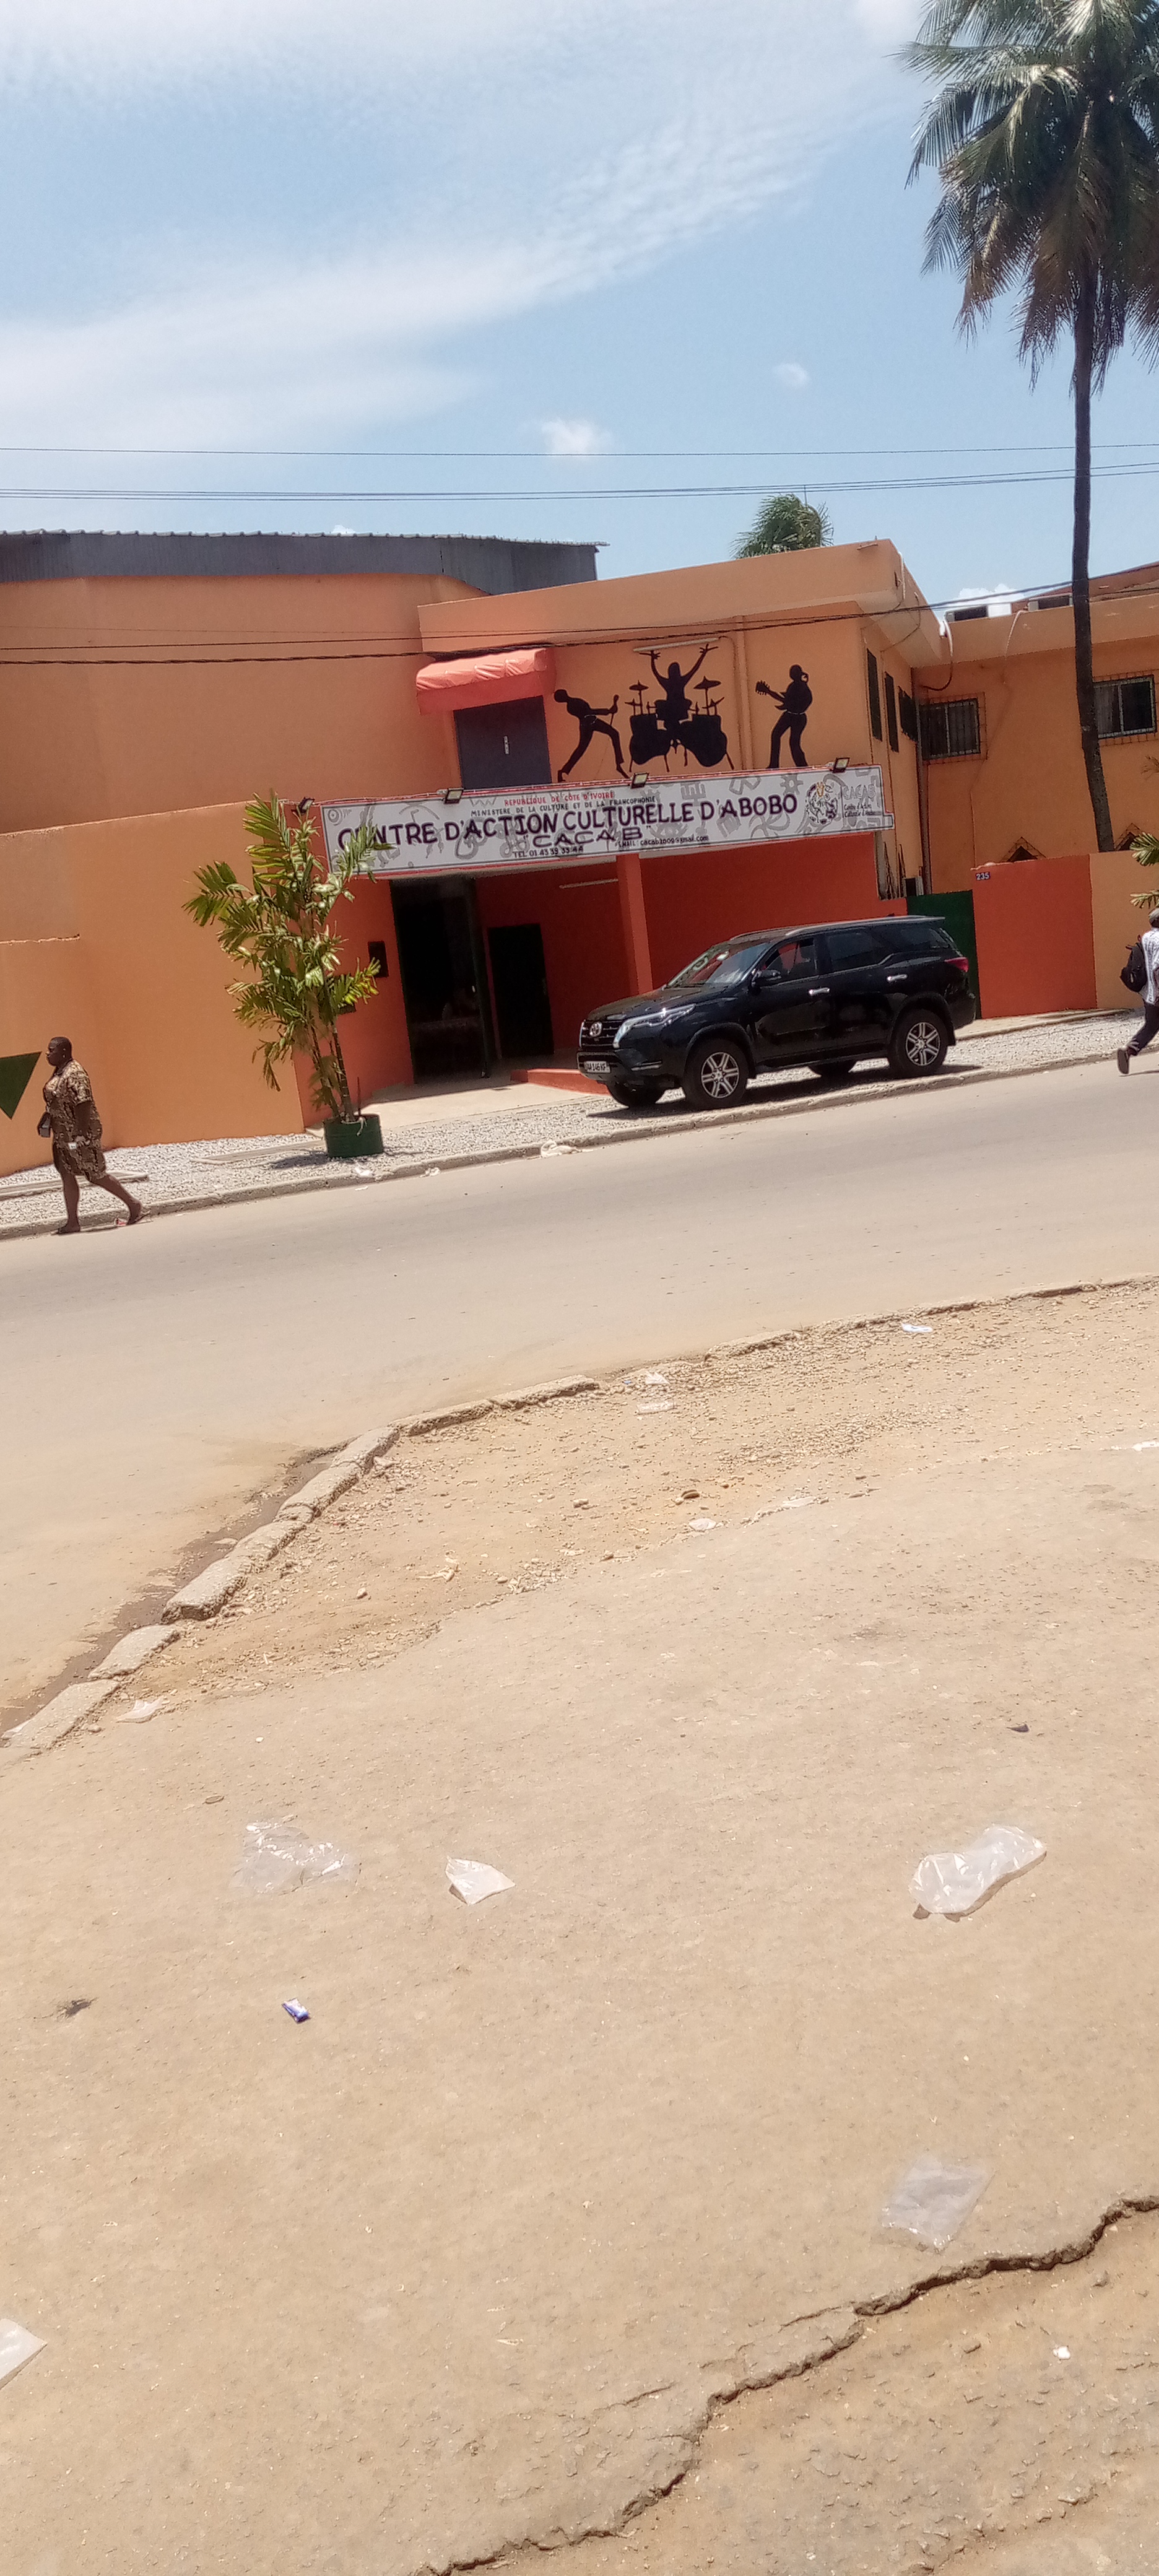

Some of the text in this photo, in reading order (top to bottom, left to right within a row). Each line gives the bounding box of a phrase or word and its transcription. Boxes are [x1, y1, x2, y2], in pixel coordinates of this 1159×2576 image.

[471, 807, 511, 817] MINISTERE
[539, 803, 569, 812] CULTURE
[609, 796, 656, 806] FRANCOPHONIE
[504, 796, 547, 806] REPUBLIQUE
[583, 791, 614, 801] D'IVOIRE
[444, 812, 558, 842] D'ACTION
[563, 802, 694, 830] CULTURELLE
[700, 793, 797, 820] D'ABOBO
[976, 872, 990, 881] 235
